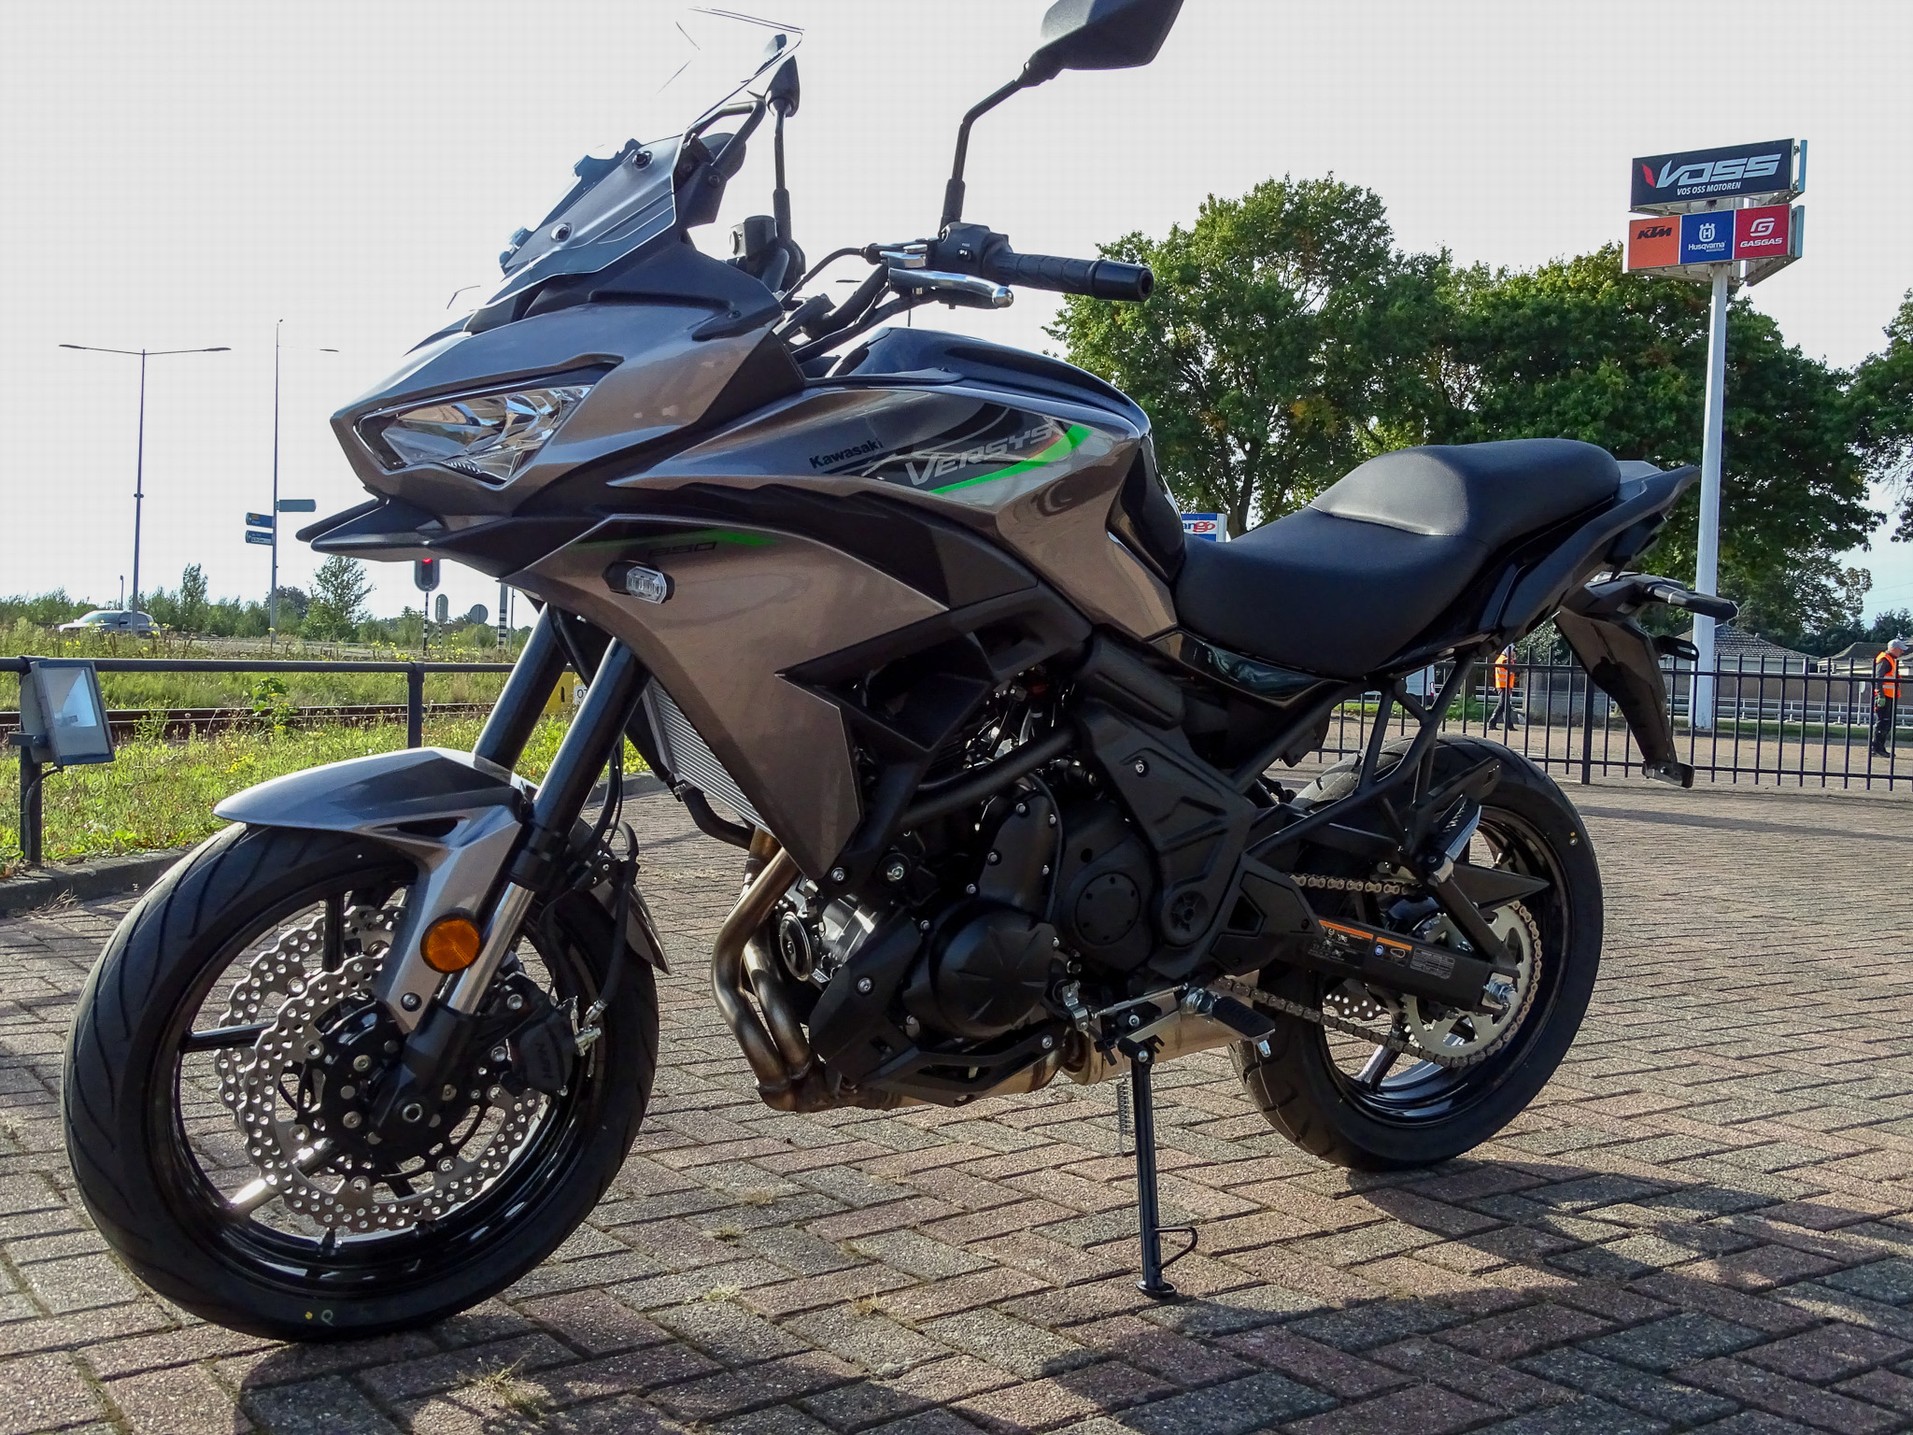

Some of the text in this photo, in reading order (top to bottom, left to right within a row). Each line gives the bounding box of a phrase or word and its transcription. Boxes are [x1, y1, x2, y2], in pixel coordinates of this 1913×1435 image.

[1656, 153, 1782, 188] VOSS
[1677, 181, 1742, 196] VOS OSS MOTOREN
[1637, 225, 1672, 240] KTM
[1688, 241, 1725, 252] Husqvarna
[1740, 237, 1783, 248] GASGAS
[808, 437, 884, 469] Kawasaki
[904, 423, 1054, 486] VERSYS
[1182, 521, 1216, 533] ango
